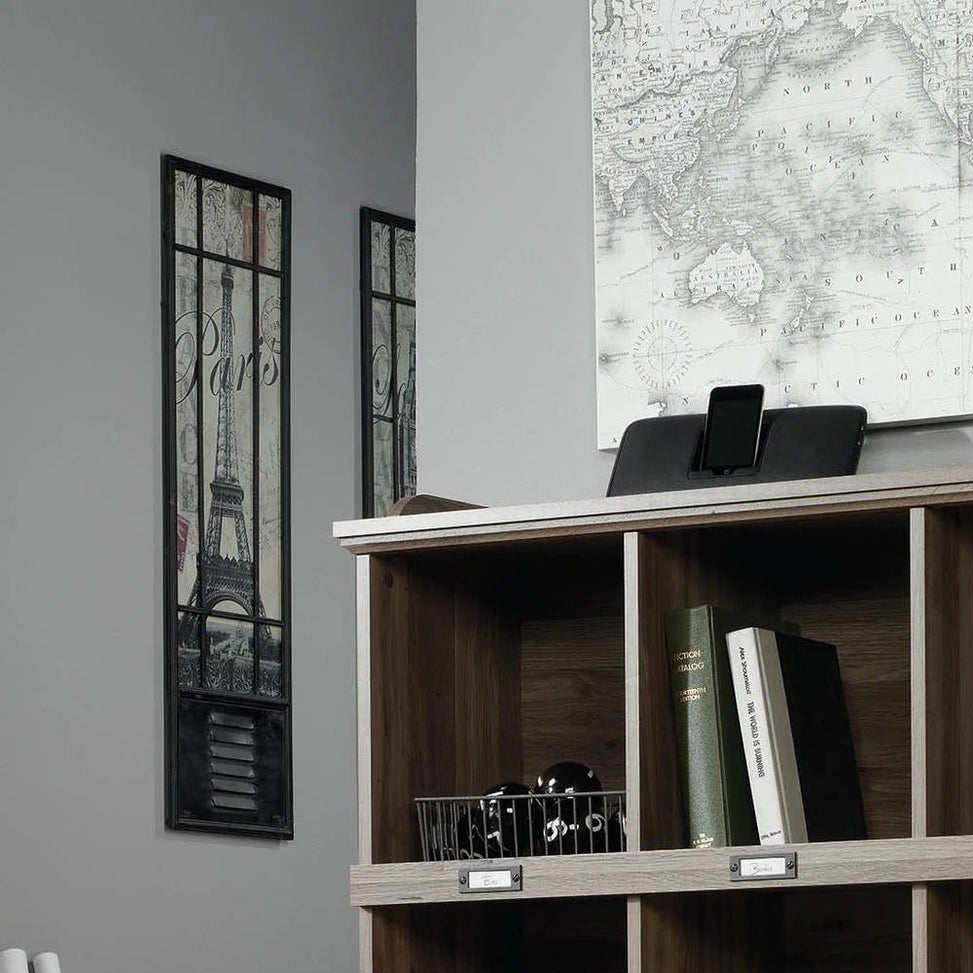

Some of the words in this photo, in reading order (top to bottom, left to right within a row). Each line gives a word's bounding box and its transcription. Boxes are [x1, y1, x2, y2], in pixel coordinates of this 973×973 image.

[782, 75, 873, 98] NORTH
[756, 110, 903, 138] PACIFIC
[825, 263, 958, 287] SOUTH
[760, 314, 878, 338] PACIFIC
[895, 304, 972, 323] OCEAN
[747, 701, 755, 714] THE
[749, 715, 760, 738] WORLD
